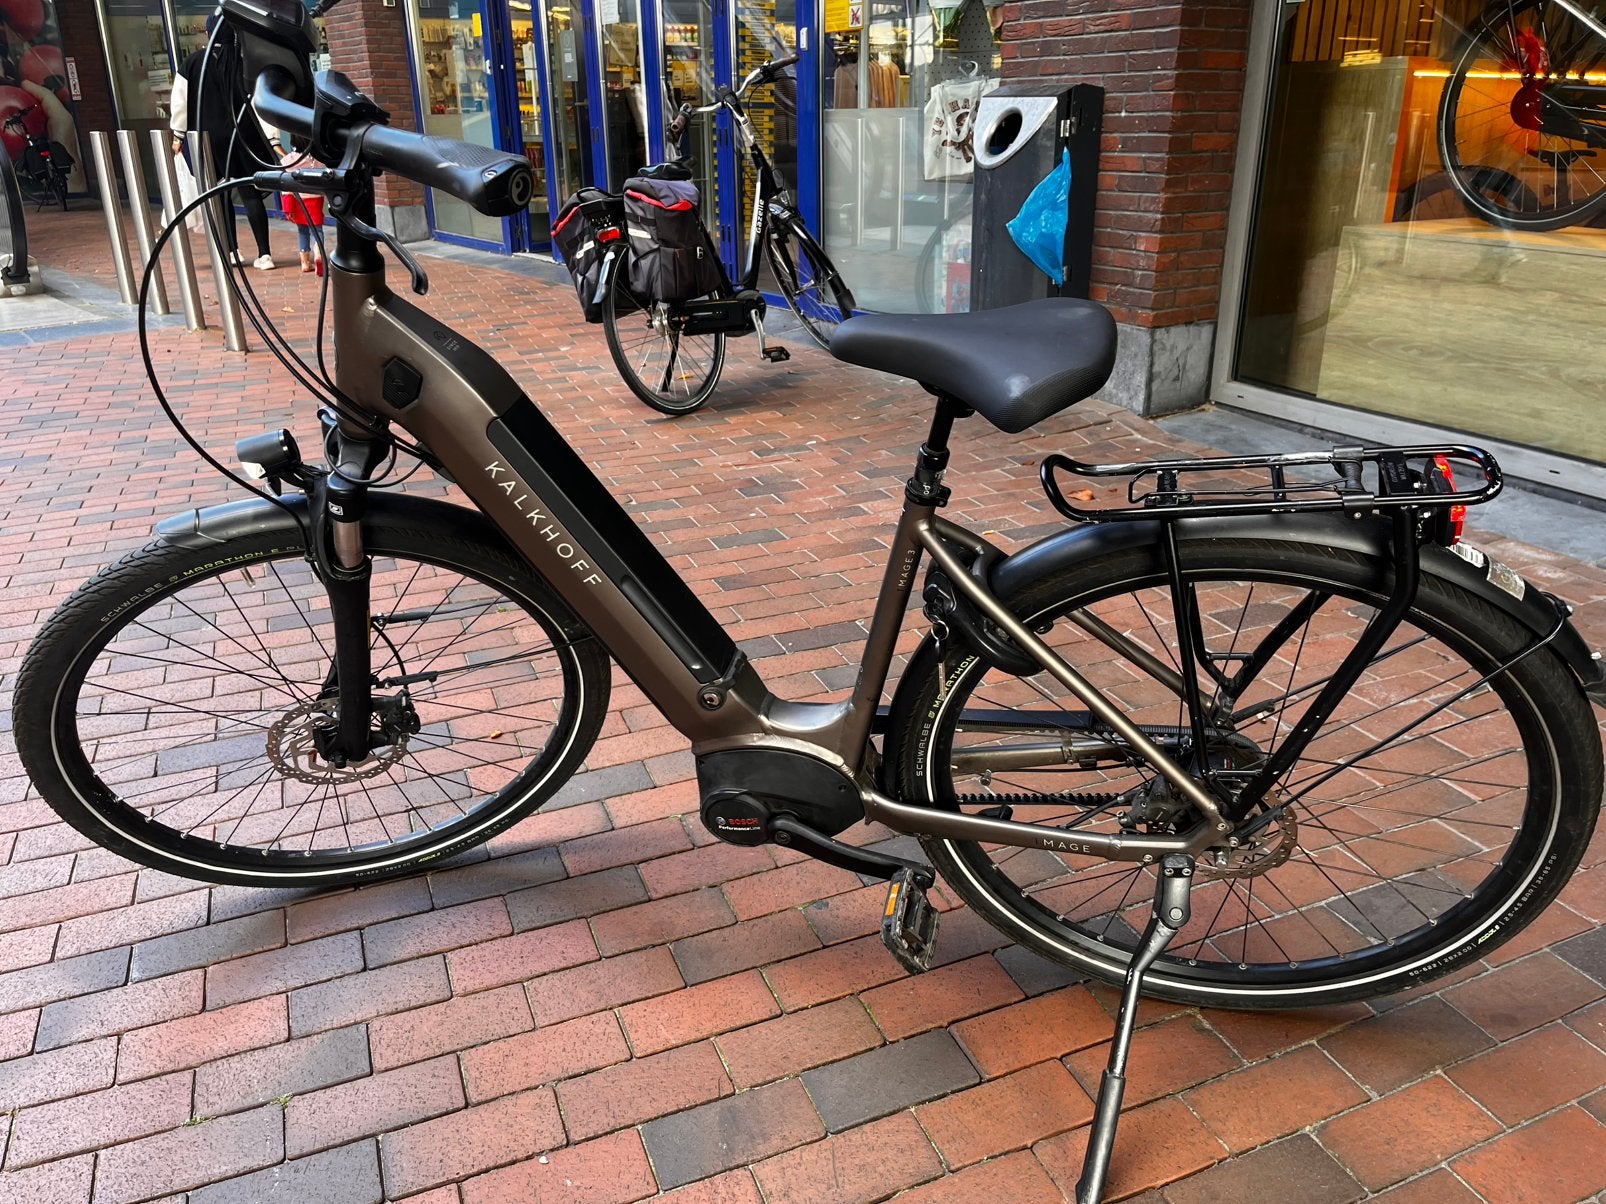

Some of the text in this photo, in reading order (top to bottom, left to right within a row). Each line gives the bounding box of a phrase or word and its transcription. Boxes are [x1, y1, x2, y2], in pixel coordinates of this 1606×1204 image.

[756, 199, 765, 234] Gazelle
[485, 460, 602, 585] KALKHOFF
[100, 581, 163, 622] SCHWALBE
[182, 550, 265, 576] MARATHON
[916, 654, 976, 777] SCHWALBE MAATHON
[728, 817, 760, 826] BOSCH
